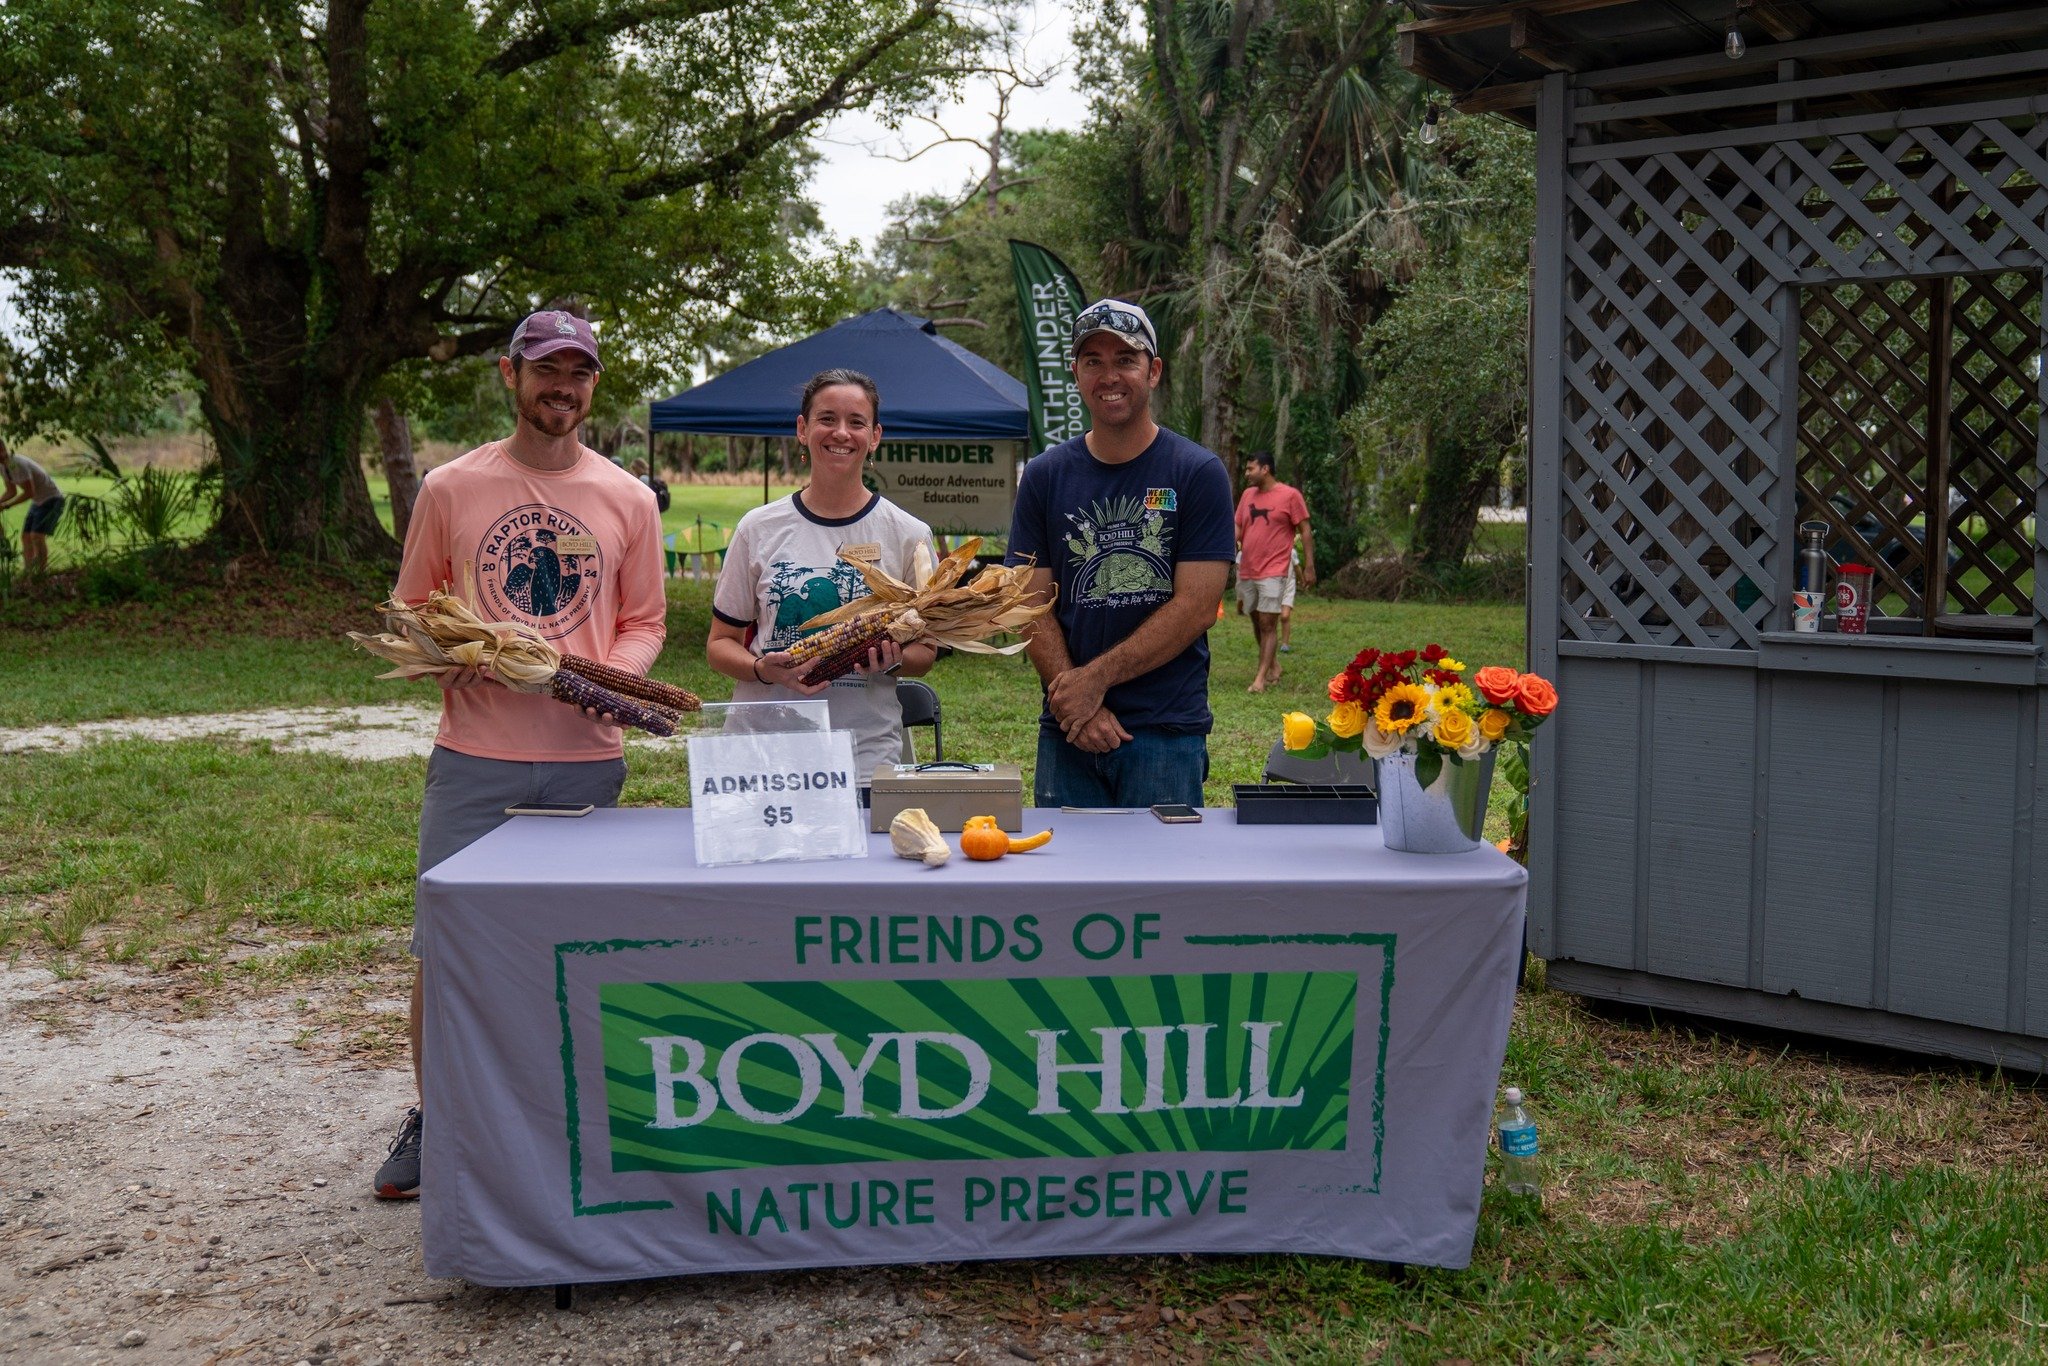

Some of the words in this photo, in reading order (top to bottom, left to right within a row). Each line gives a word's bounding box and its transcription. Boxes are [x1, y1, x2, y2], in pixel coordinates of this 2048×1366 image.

[1032, 281, 1066, 450] ATHFINDER
[1066, 383, 1083, 439] DOOR
[875, 443, 994, 464] THFINDER
[898, 474, 943, 487] Outdoor
[947, 475, 1005, 488] Adventure
[924, 491, 979, 504] Education
[486, 512, 541, 555] RAPTOR
[547, 514, 579, 536] RUN
[1118, 530, 1135, 538] HILL
[482, 563, 496, 571] 20
[584, 570, 597, 578] 24
[487, 579, 503, 608] FRIENDS
[502, 607, 511, 615] OF
[549, 615, 569, 628] NARE
[702, 771, 847, 795] ADMISSION
[763, 805, 793, 827] $5
[795, 914, 1043, 964] FRIENDS
[1072, 912, 1160, 960] OF
[639, 1031, 992, 1129] BOYD
[1025, 1021, 1304, 1115] HILL
[706, 1178, 935, 1237] NATURE
[964, 1169, 1248, 1222] PRESERVE
